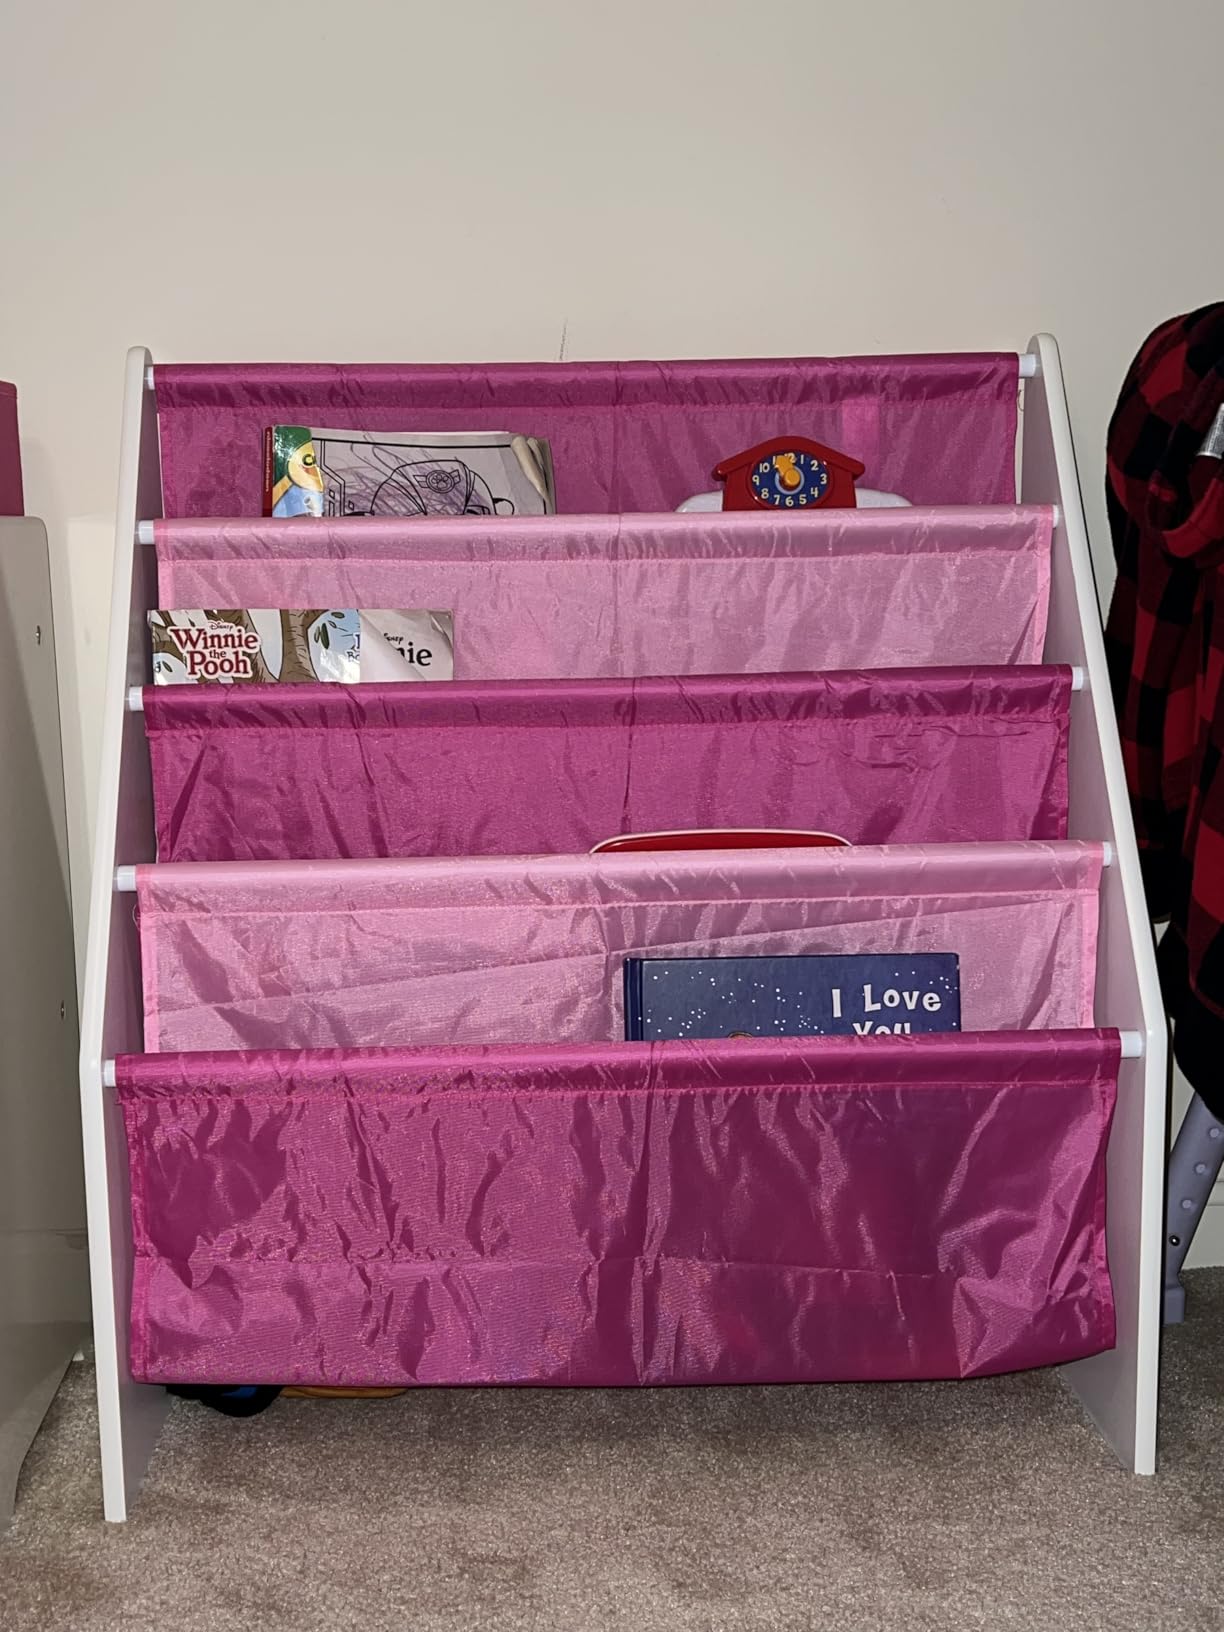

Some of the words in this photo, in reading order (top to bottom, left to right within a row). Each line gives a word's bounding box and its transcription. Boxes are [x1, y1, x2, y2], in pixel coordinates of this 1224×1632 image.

[759, 462, 770, 473] 10
[810, 460, 819, 471] 2
[752, 475, 760, 486] 9
[820, 474, 828, 485] 3
[761, 488, 769, 499] 8
[810, 487, 819, 498] 4
[774, 495, 781, 505] 7
[785, 496, 794, 507] 6
[799, 495, 807, 505] 5
[170, 628, 258, 650] Winnie
[209, 649, 227, 659] the
[186, 650, 249, 676] Pooh
[831, 988, 842, 1018] I
[863, 983, 942, 1013] Love
